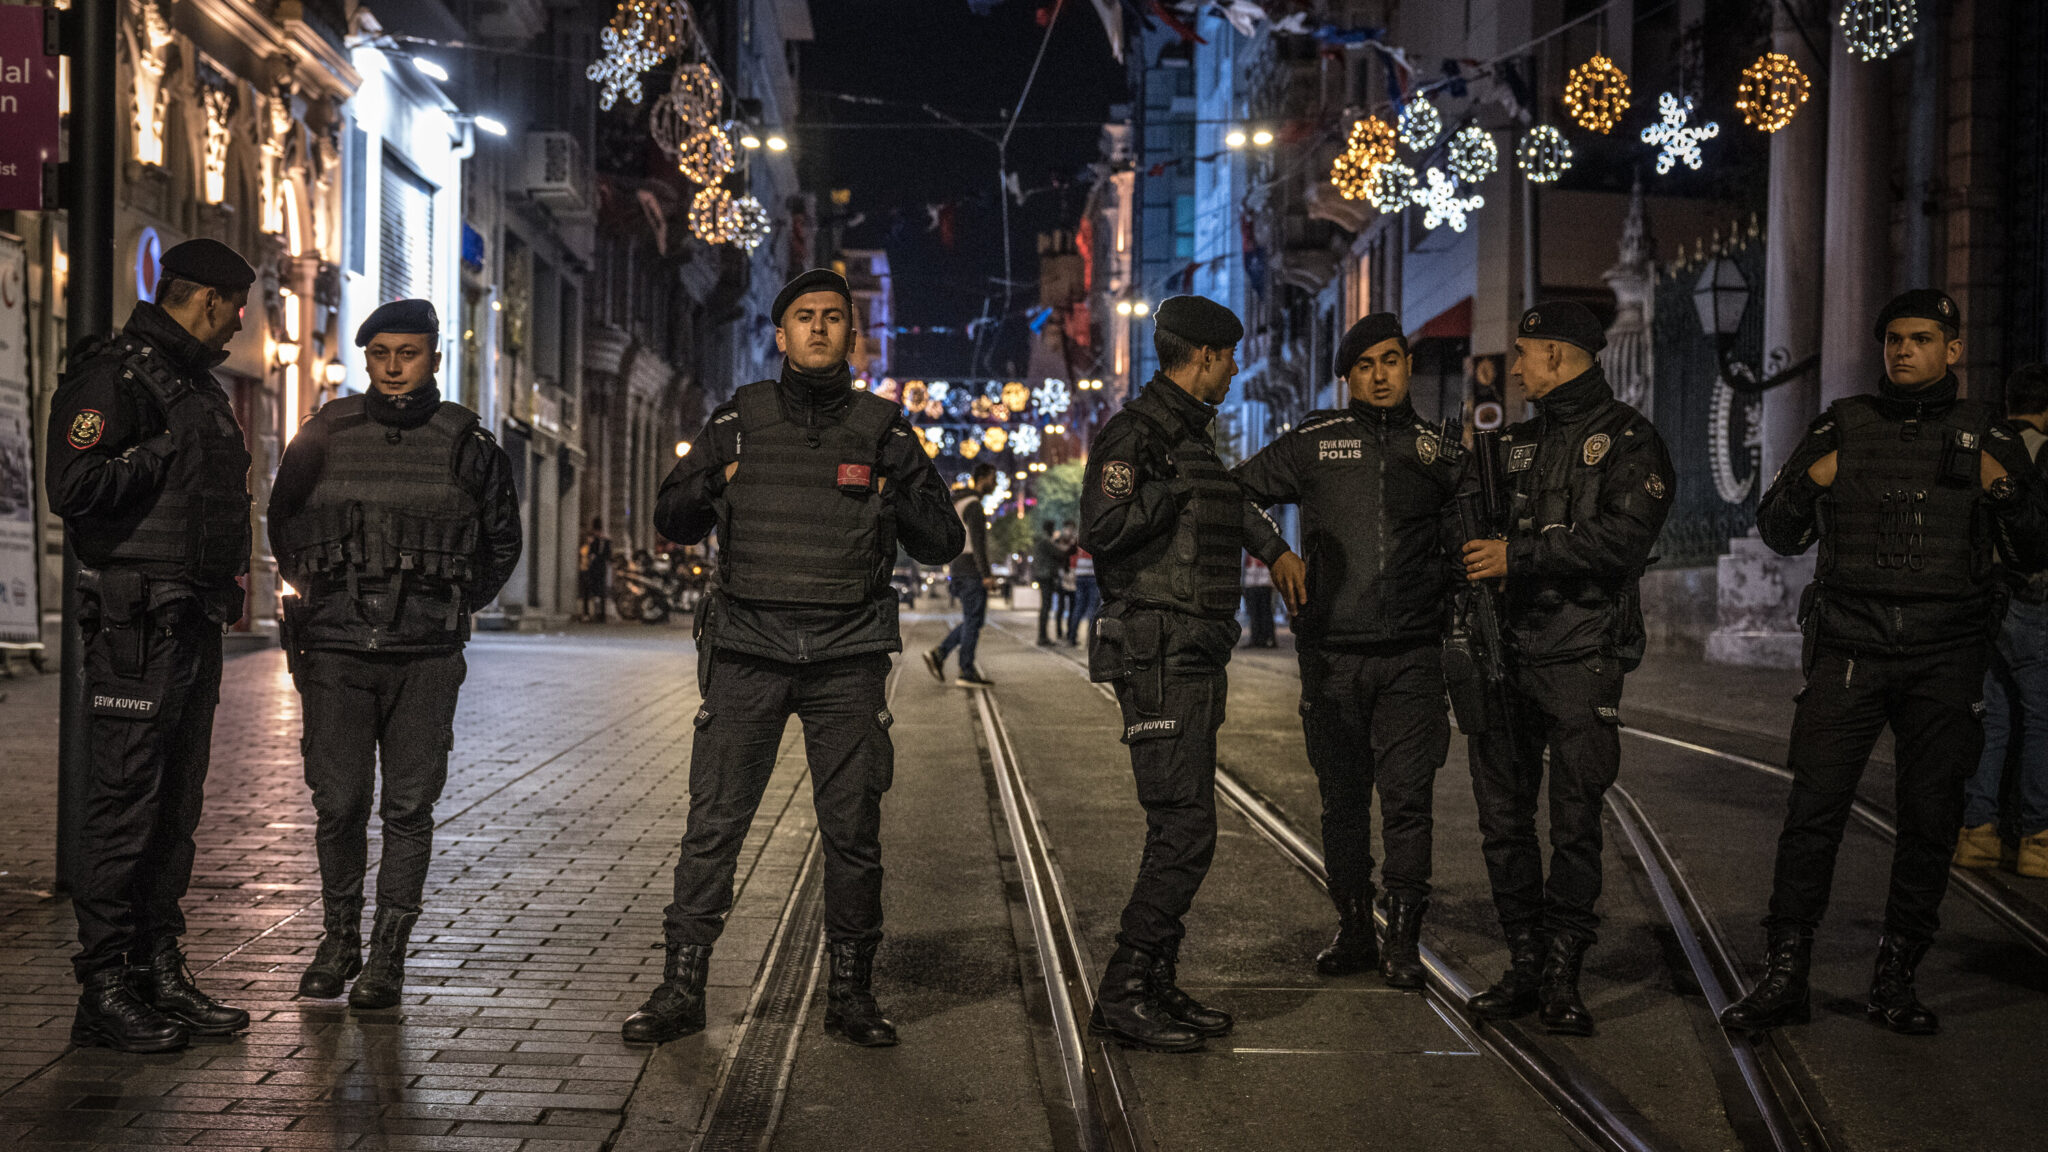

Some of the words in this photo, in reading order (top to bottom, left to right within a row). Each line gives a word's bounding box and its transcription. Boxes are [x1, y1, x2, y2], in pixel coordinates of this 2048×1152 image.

[0, 56, 30, 84] al
[1338, 439, 1362, 449] KUVVET
[115, 698, 154, 711] KUVVET
[1143, 720, 1176, 730] KUVVET
